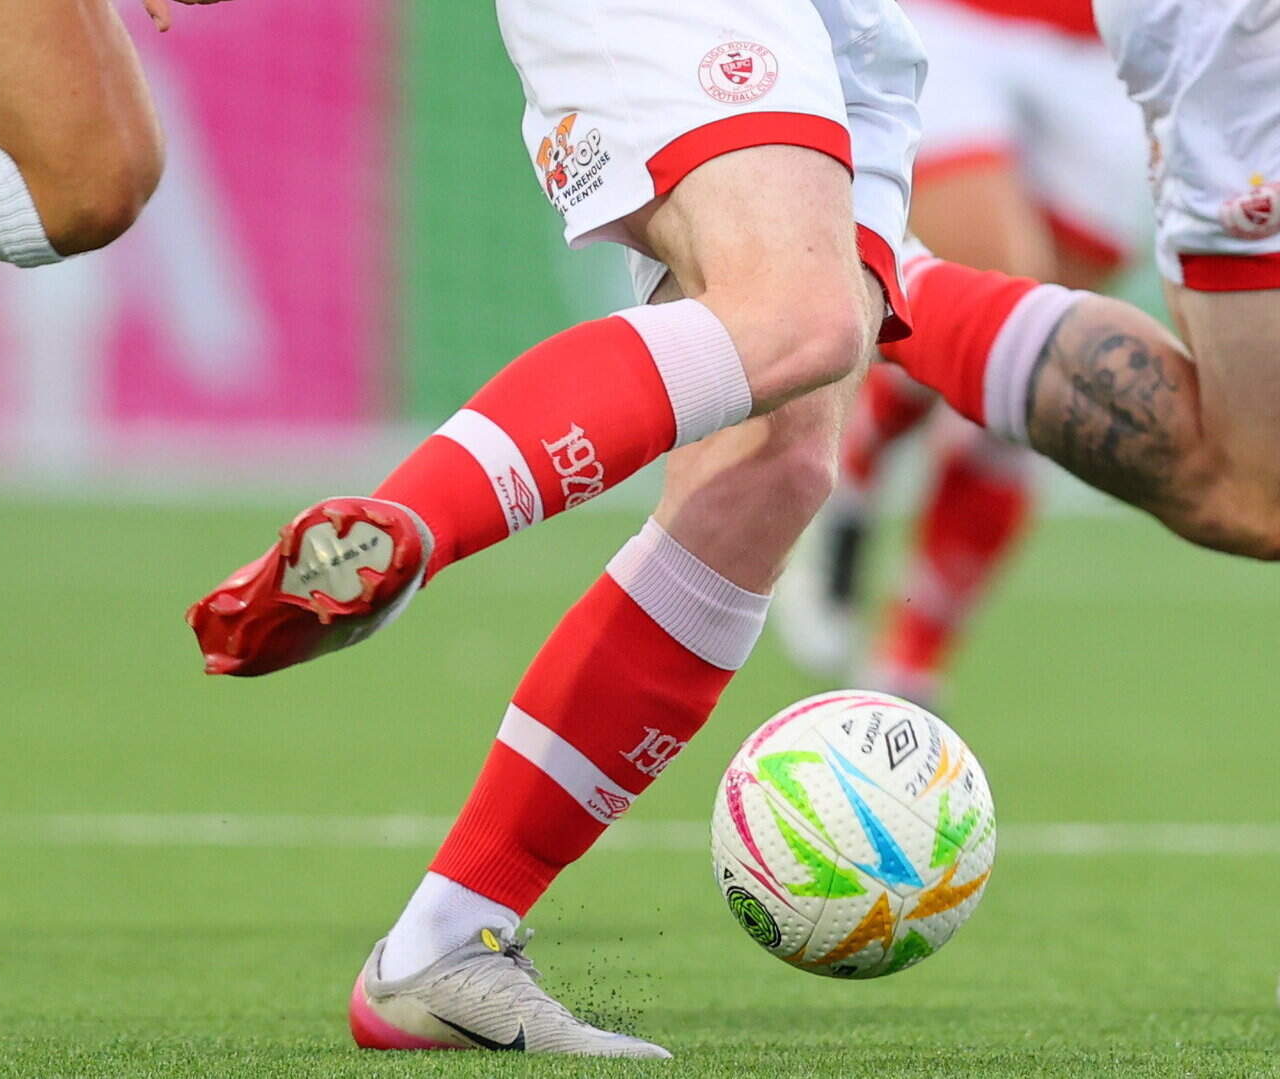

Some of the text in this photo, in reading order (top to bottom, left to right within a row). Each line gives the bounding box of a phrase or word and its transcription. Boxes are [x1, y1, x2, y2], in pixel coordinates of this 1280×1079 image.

[563, 151, 611, 200] WAREHOUSE
[569, 175, 604, 207] CENTRE
[860, 710, 883, 754] umbro
